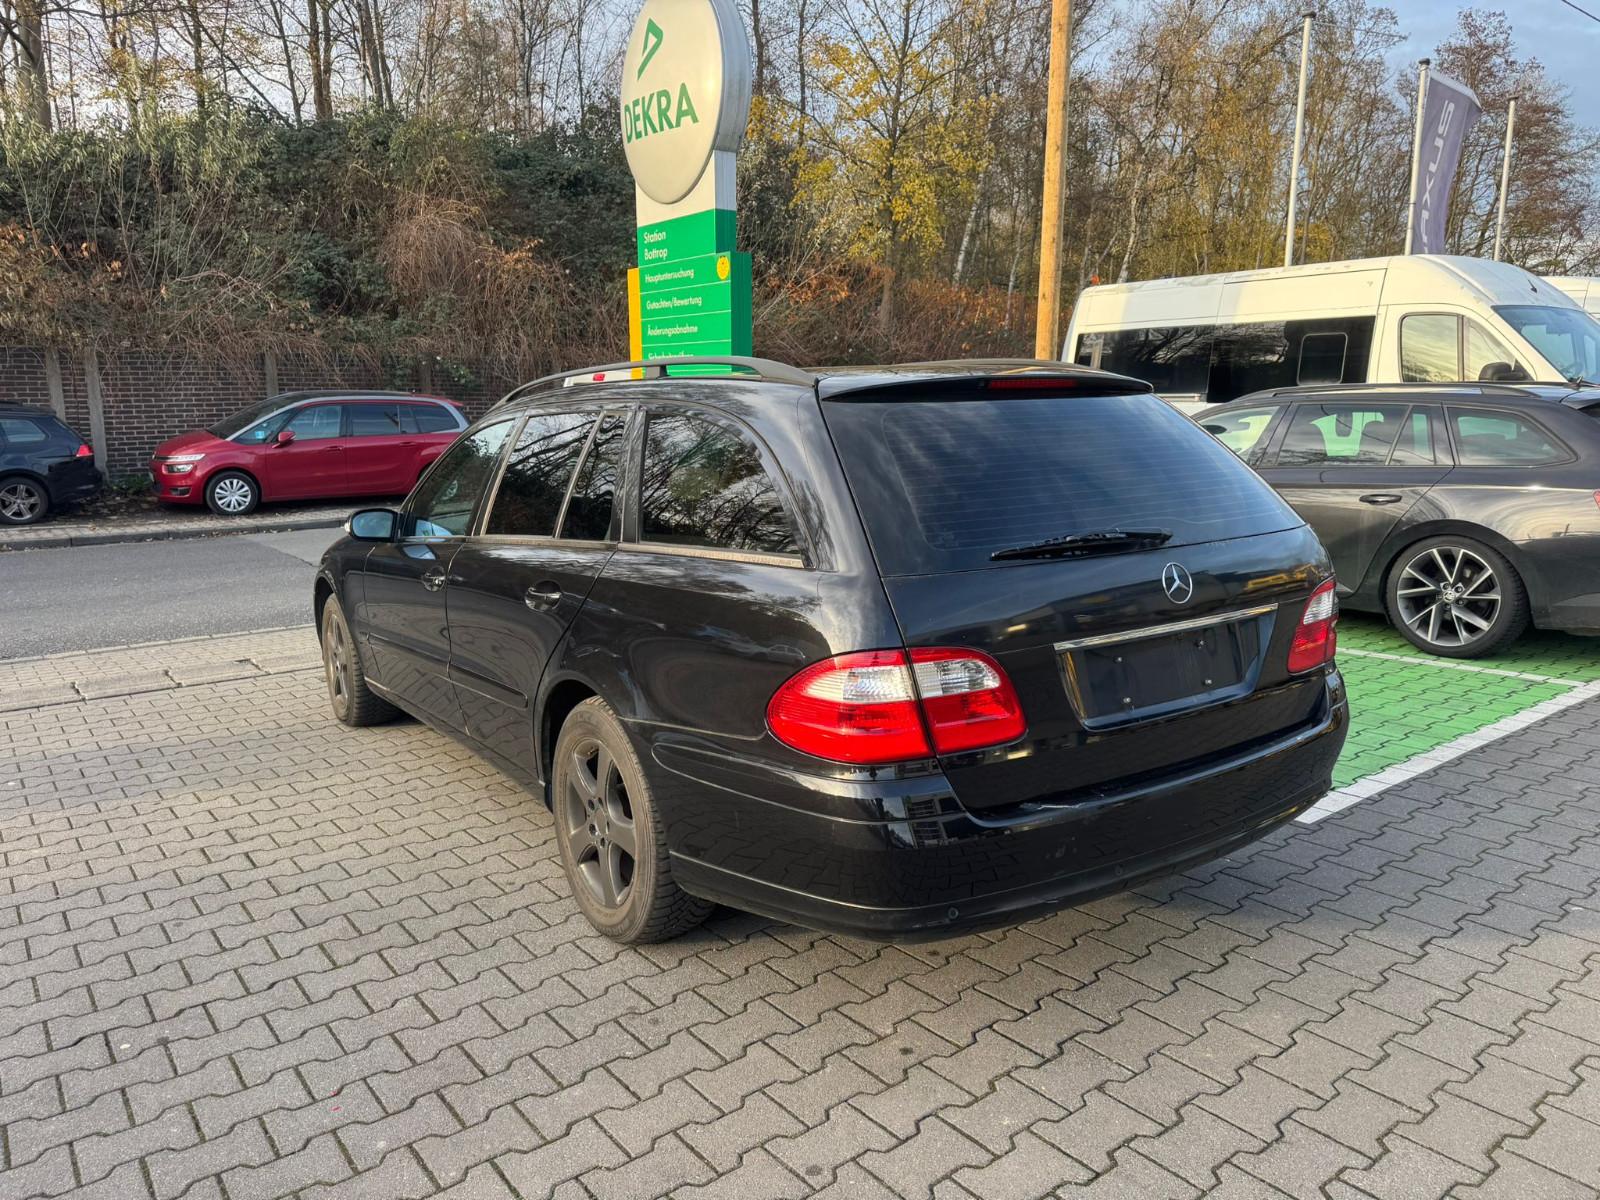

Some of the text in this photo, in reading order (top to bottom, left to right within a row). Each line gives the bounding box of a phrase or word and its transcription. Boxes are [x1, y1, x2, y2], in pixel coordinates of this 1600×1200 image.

[624, 82, 699, 144] DEKRA
[1420, 100, 1455, 254] AXUS
[643, 229, 667, 244] Station
[644, 247, 668, 261] Bottrop
[645, 267, 695, 284] Hauptuntersuchung
[646, 296, 702, 310] Gutachten/Bewertung
[647, 323, 699, 337] Änderungsabnahme
